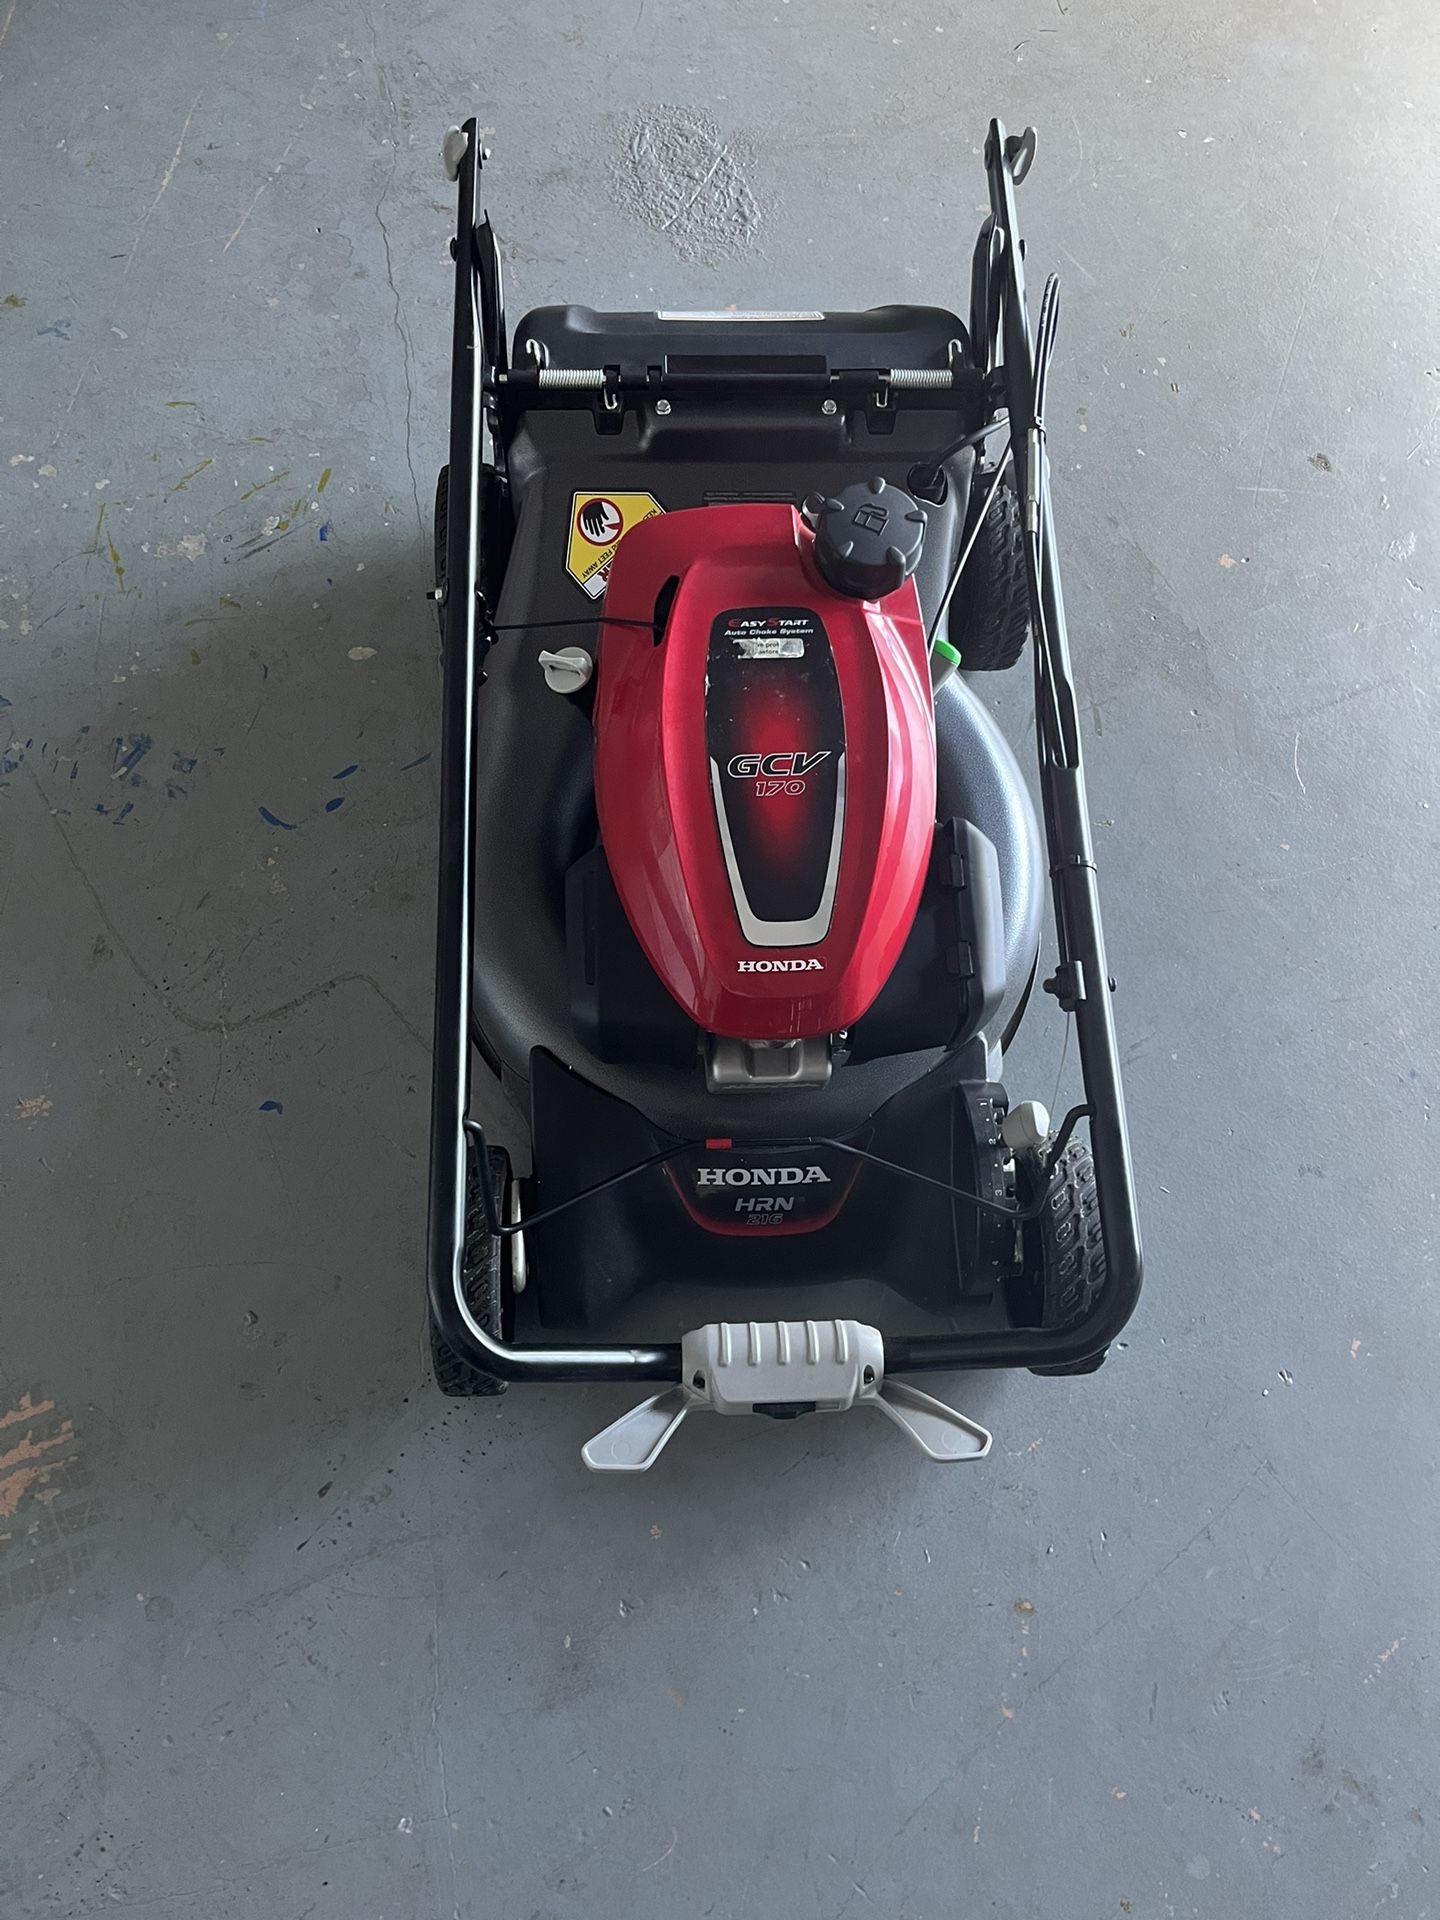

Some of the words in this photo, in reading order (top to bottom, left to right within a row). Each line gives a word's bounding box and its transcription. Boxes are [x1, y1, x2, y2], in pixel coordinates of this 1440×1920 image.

[597, 548, 613, 563] FEET
[582, 561, 599, 579] AWAY
[779, 628, 814, 636] System
[727, 750, 833, 779] GCV
[755, 779, 806, 797] 170
[737, 958, 825, 973] HONDA
[697, 1165, 832, 1186] HONDA
[994, 1189, 1003, 1197] 3
[734, 1196, 795, 1212] HRN
[746, 1213, 784, 1226] 216
